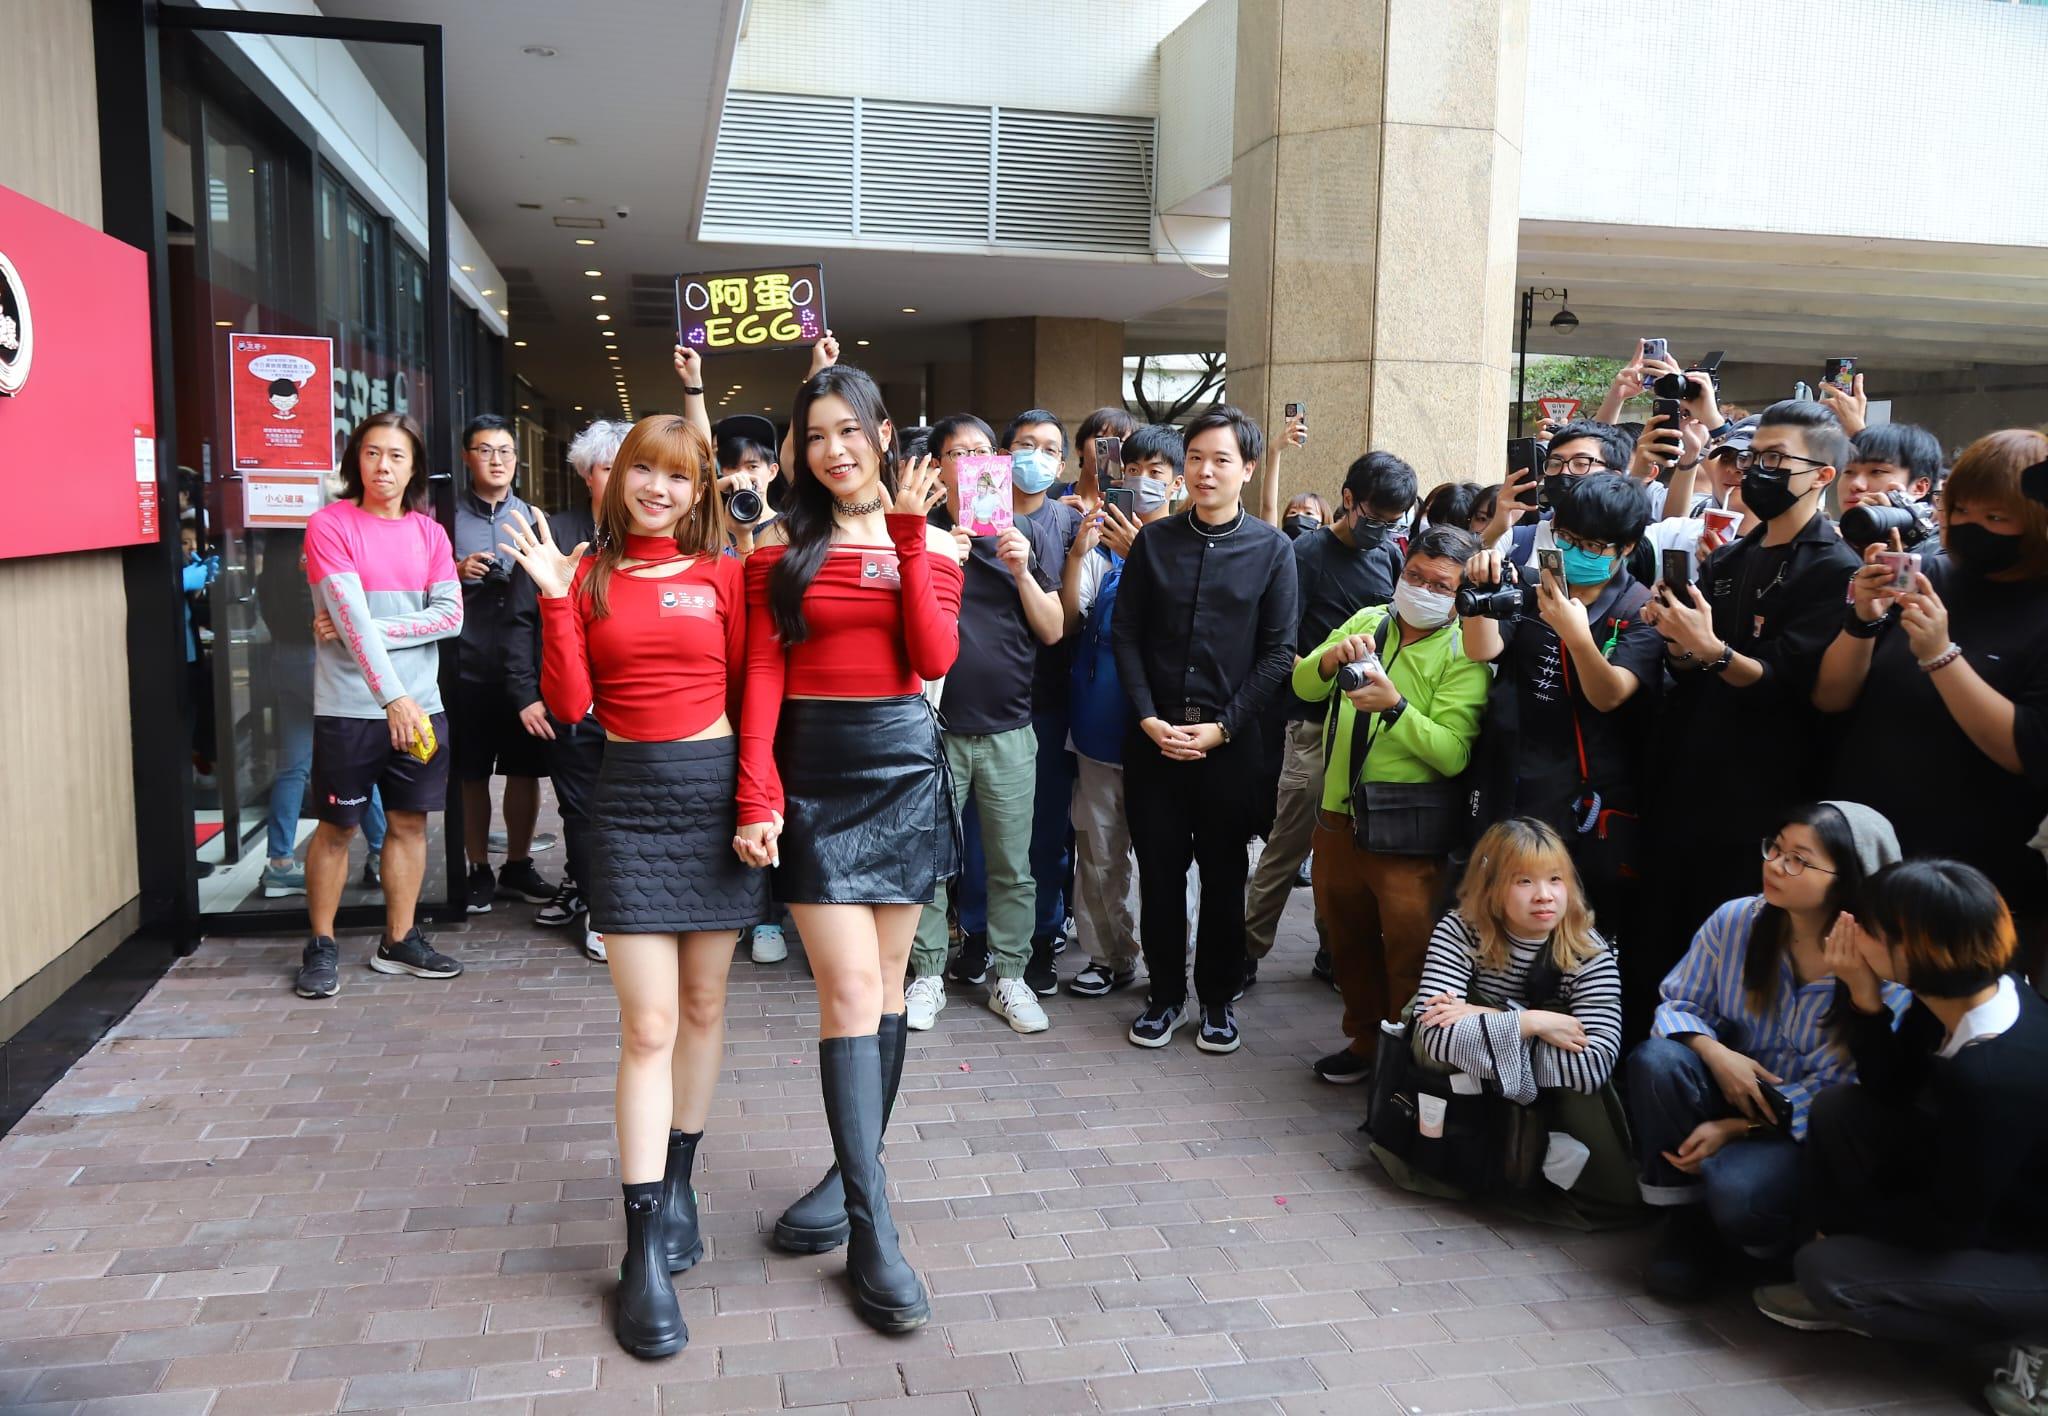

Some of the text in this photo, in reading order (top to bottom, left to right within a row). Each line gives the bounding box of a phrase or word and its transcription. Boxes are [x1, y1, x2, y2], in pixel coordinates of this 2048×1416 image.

[707, 274, 793, 315] 阿蛋
[705, 312, 801, 347] EGG
[265, 494, 304, 504] 小心玻璃
[338, 603, 383, 693] foodpanda
